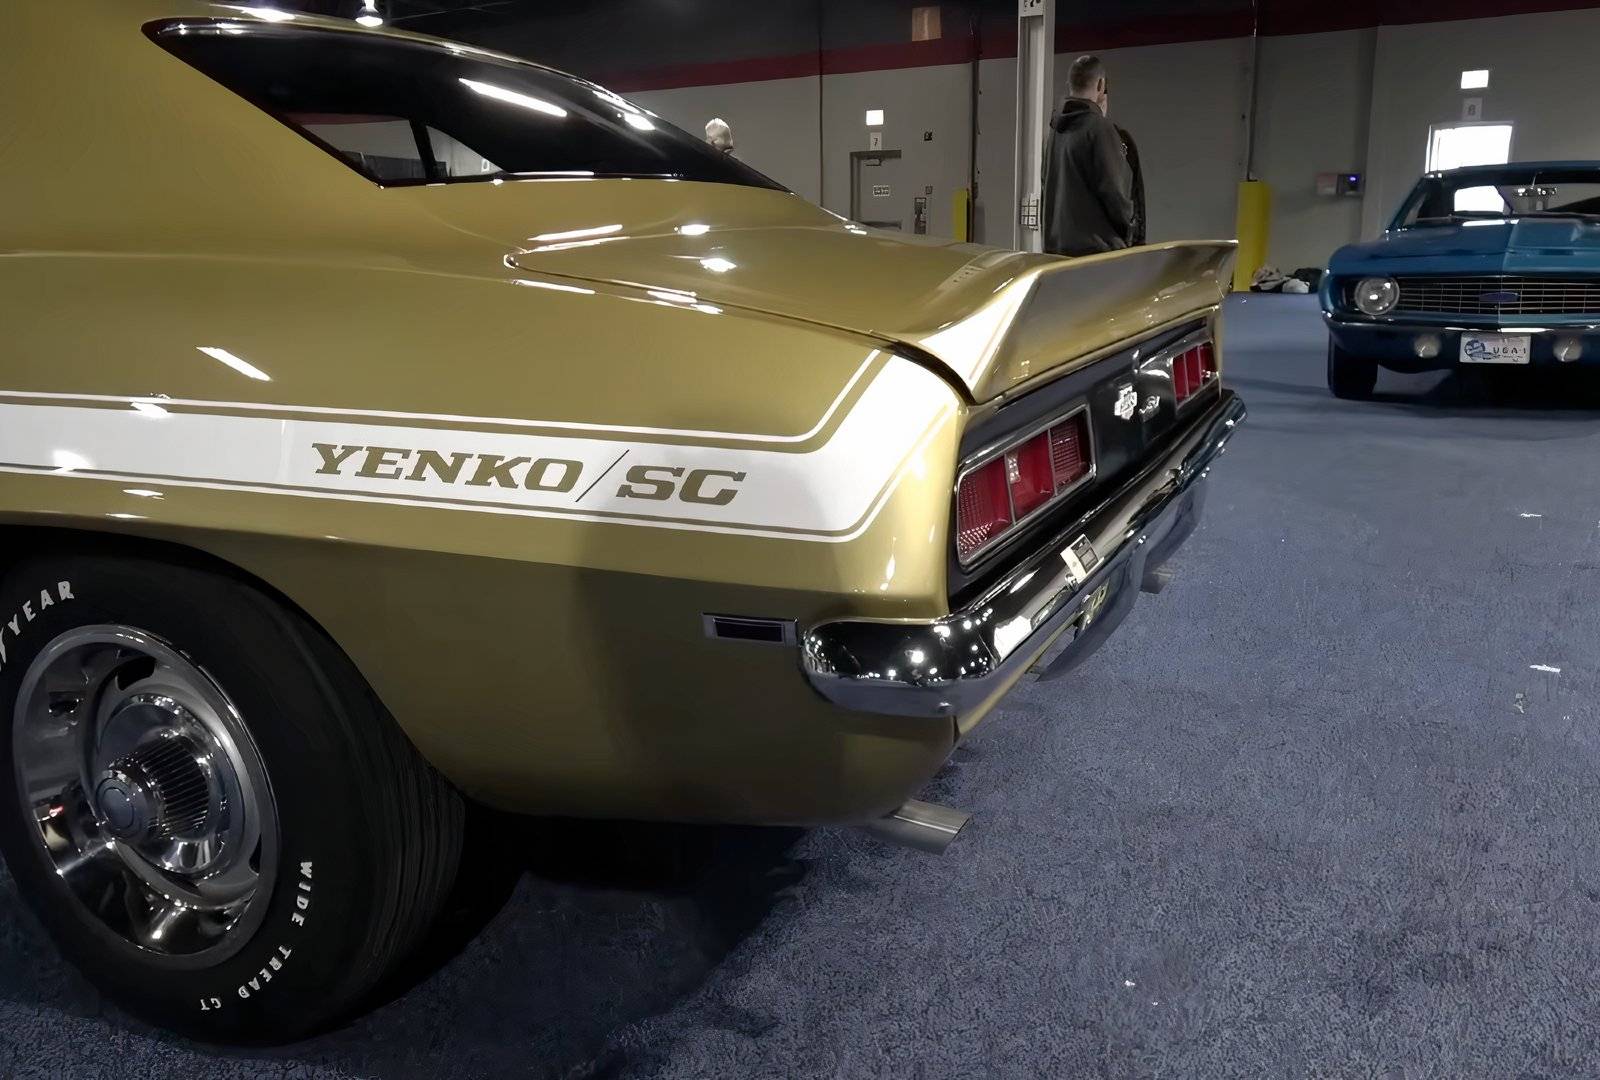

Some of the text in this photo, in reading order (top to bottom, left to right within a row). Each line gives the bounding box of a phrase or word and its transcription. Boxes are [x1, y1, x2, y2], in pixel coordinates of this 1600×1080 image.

[873, 137, 878, 146] 7
[7, 580, 75, 636] YEAR
[291, 861, 313, 927] WIDE
[238, 945, 292, 998] TREAD
